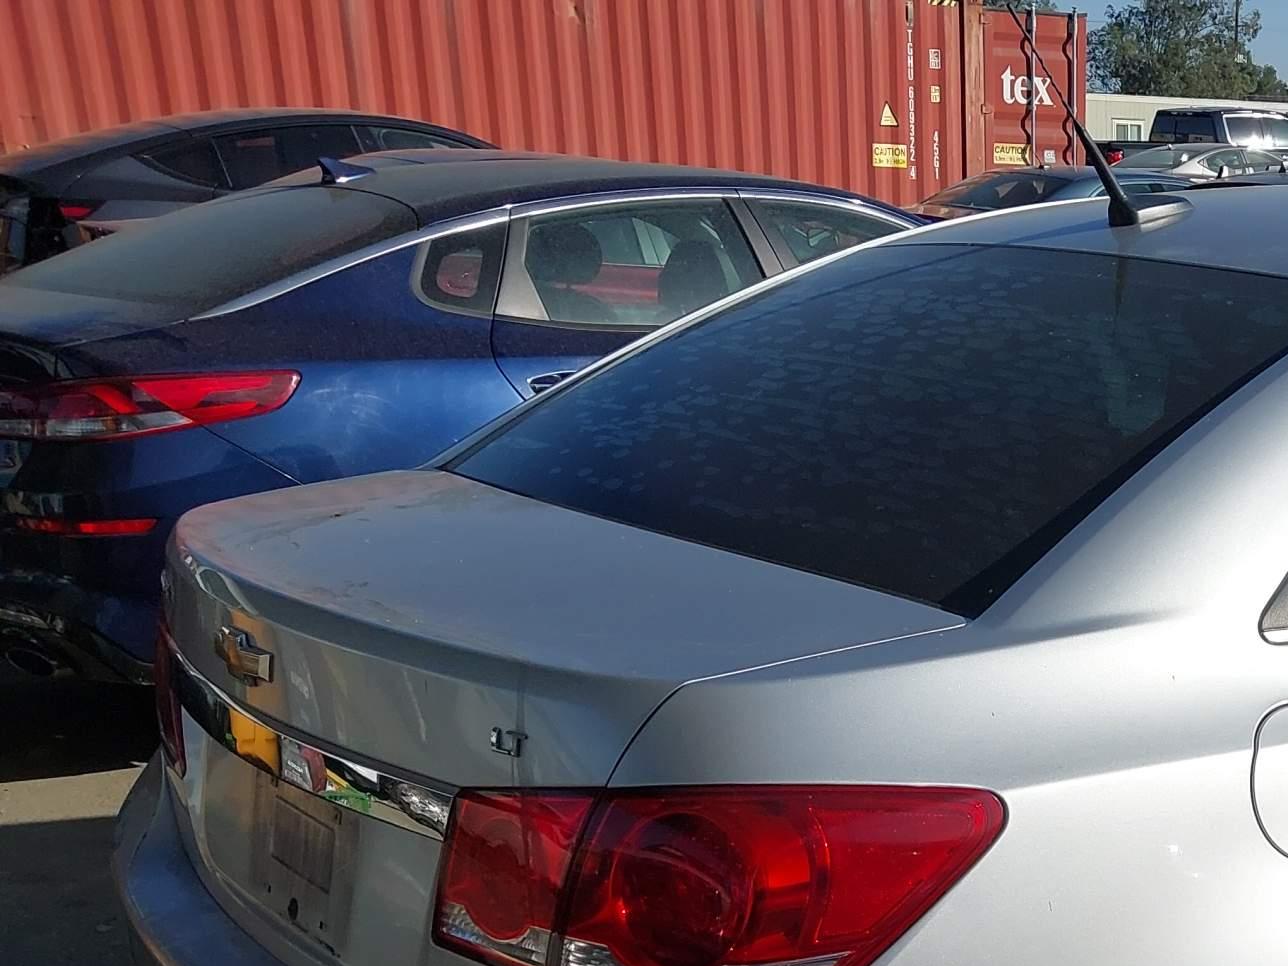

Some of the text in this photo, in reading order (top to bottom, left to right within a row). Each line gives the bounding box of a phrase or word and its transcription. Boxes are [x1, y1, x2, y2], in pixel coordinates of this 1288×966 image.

[906, 29, 914, 81] TGHU
[1000, 64, 1054, 106] tex
[908, 86, 917, 162] 609322
[874, 146, 906, 157] CAUTION
[490, 726, 528, 759] LT
